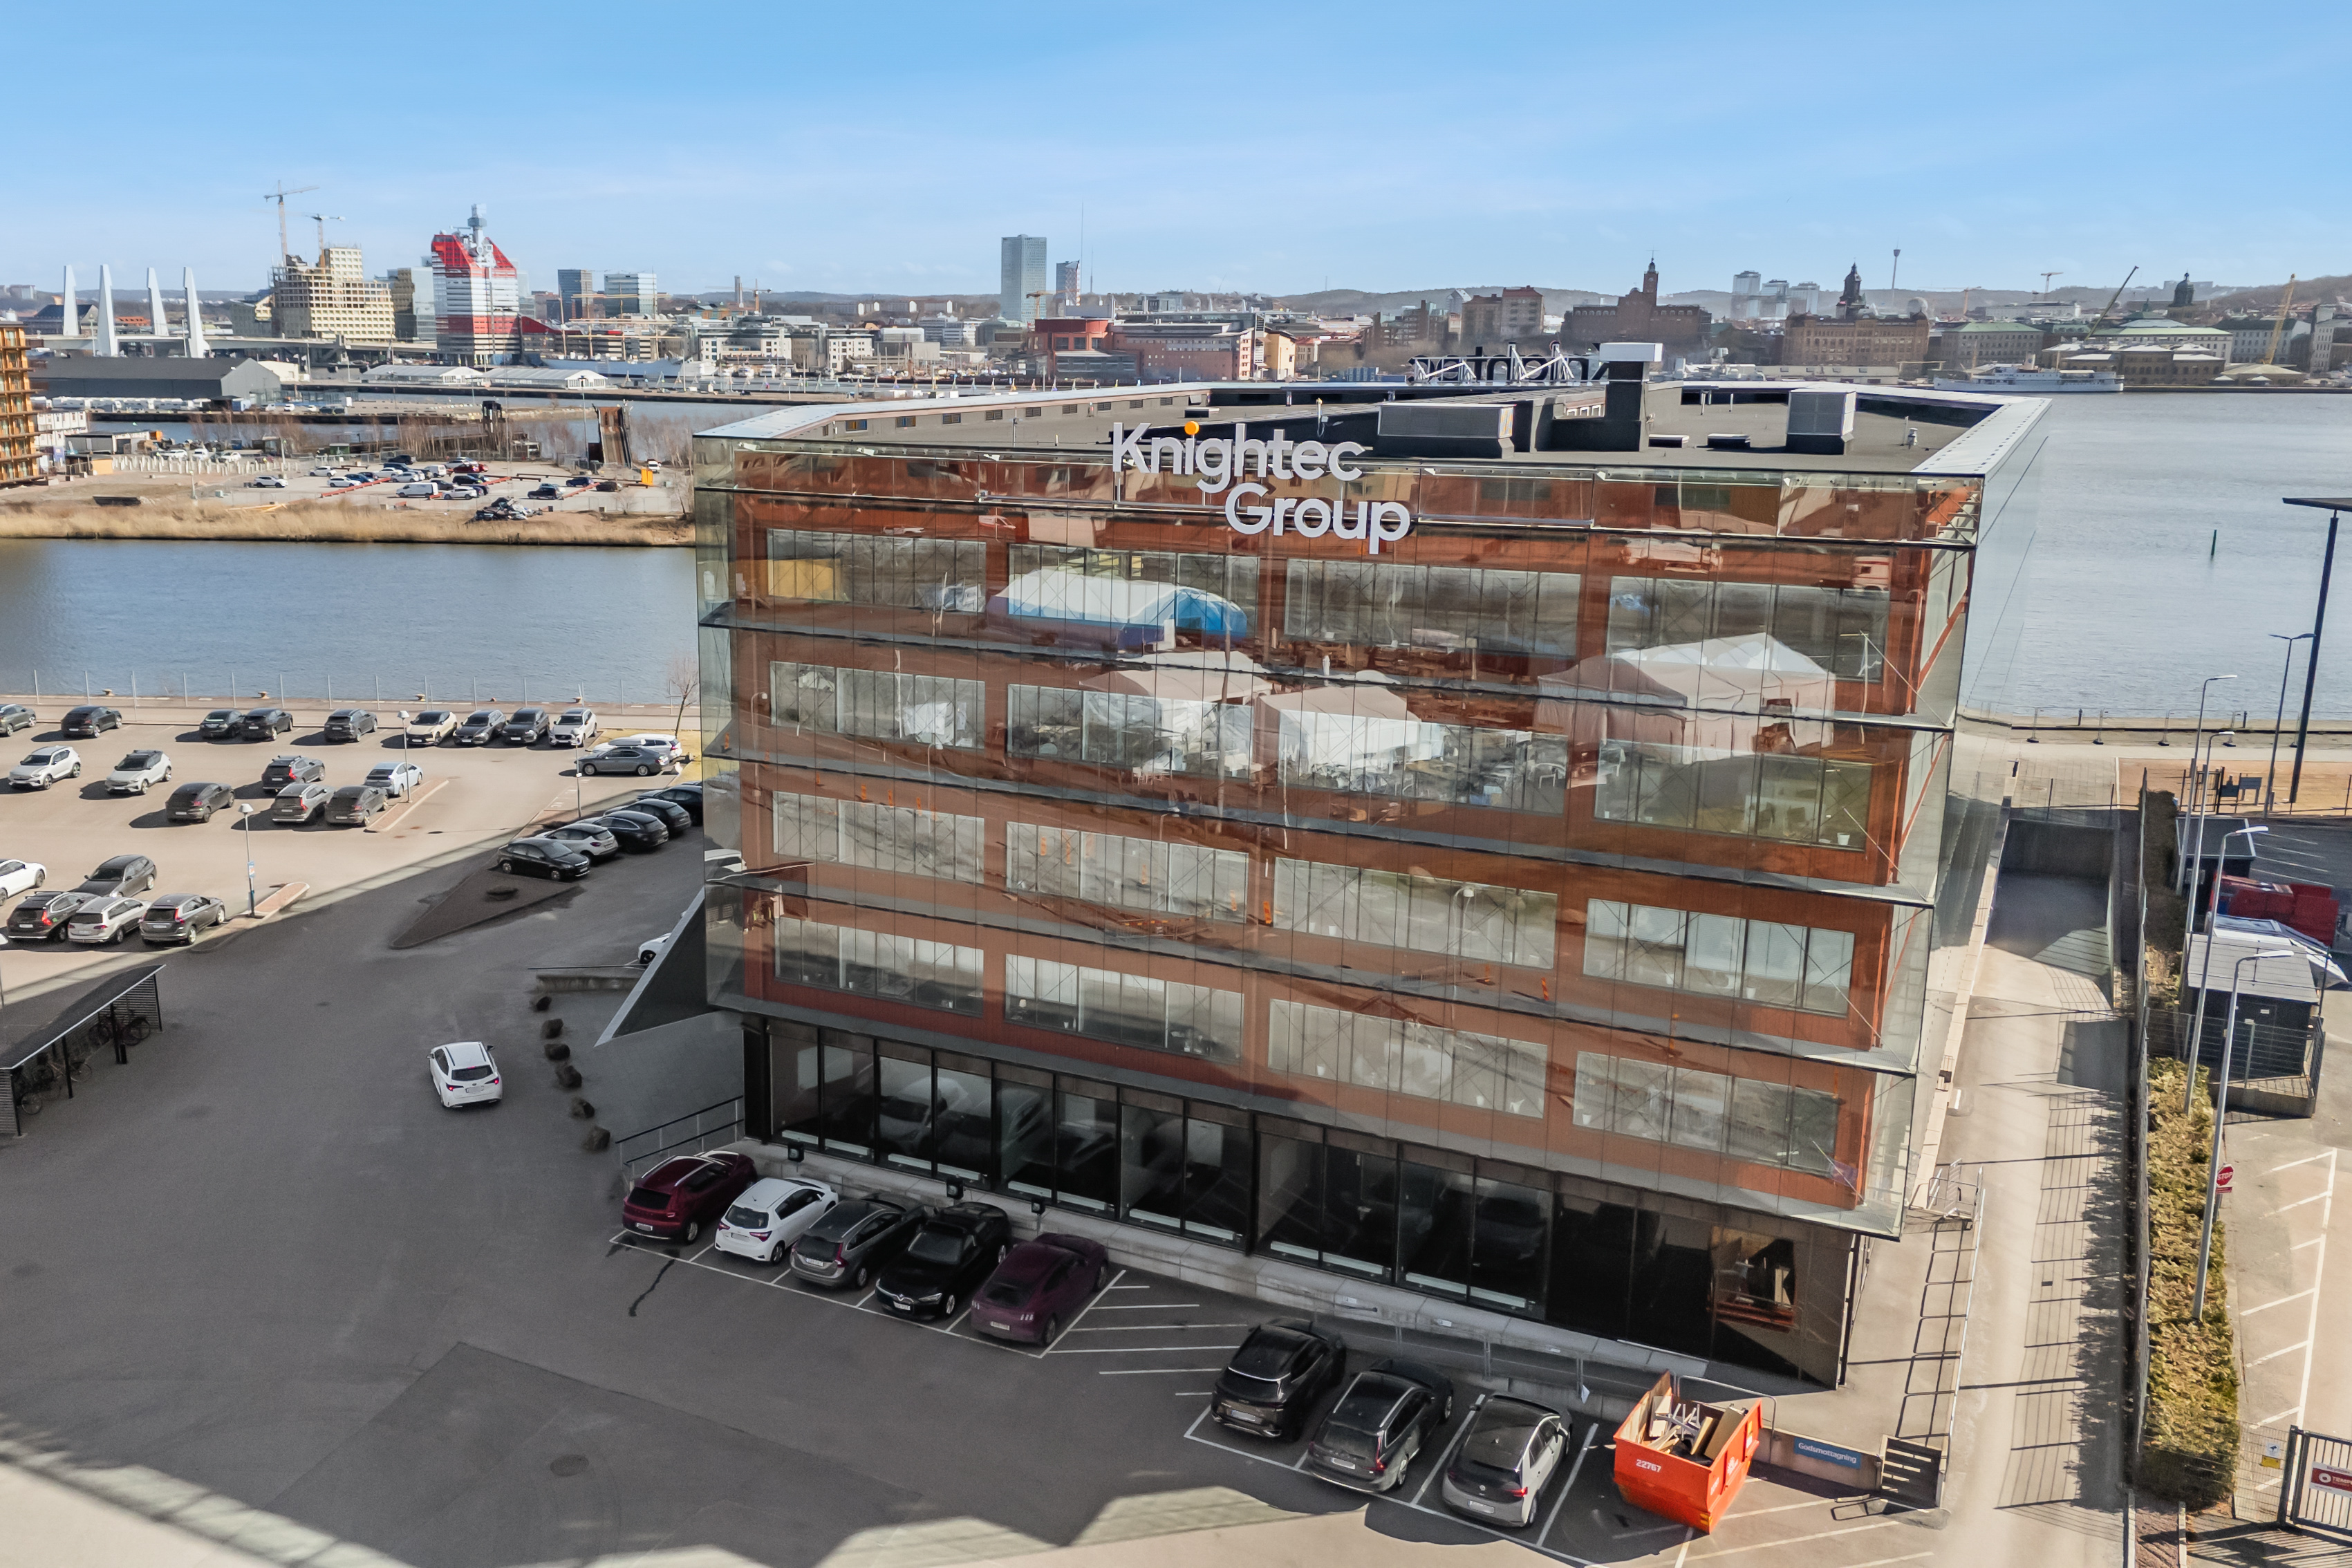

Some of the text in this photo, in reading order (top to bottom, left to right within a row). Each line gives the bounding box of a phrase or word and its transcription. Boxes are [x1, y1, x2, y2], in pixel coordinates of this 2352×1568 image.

[1112, 420, 1366, 494] Knightec
[1225, 483, 1410, 554] Group
[2217, 1171, 2233, 1180] STOP
[1798, 1442, 1856, 1464] Godsmottagning
[2332, 1475, 2352, 1485] TEMP
